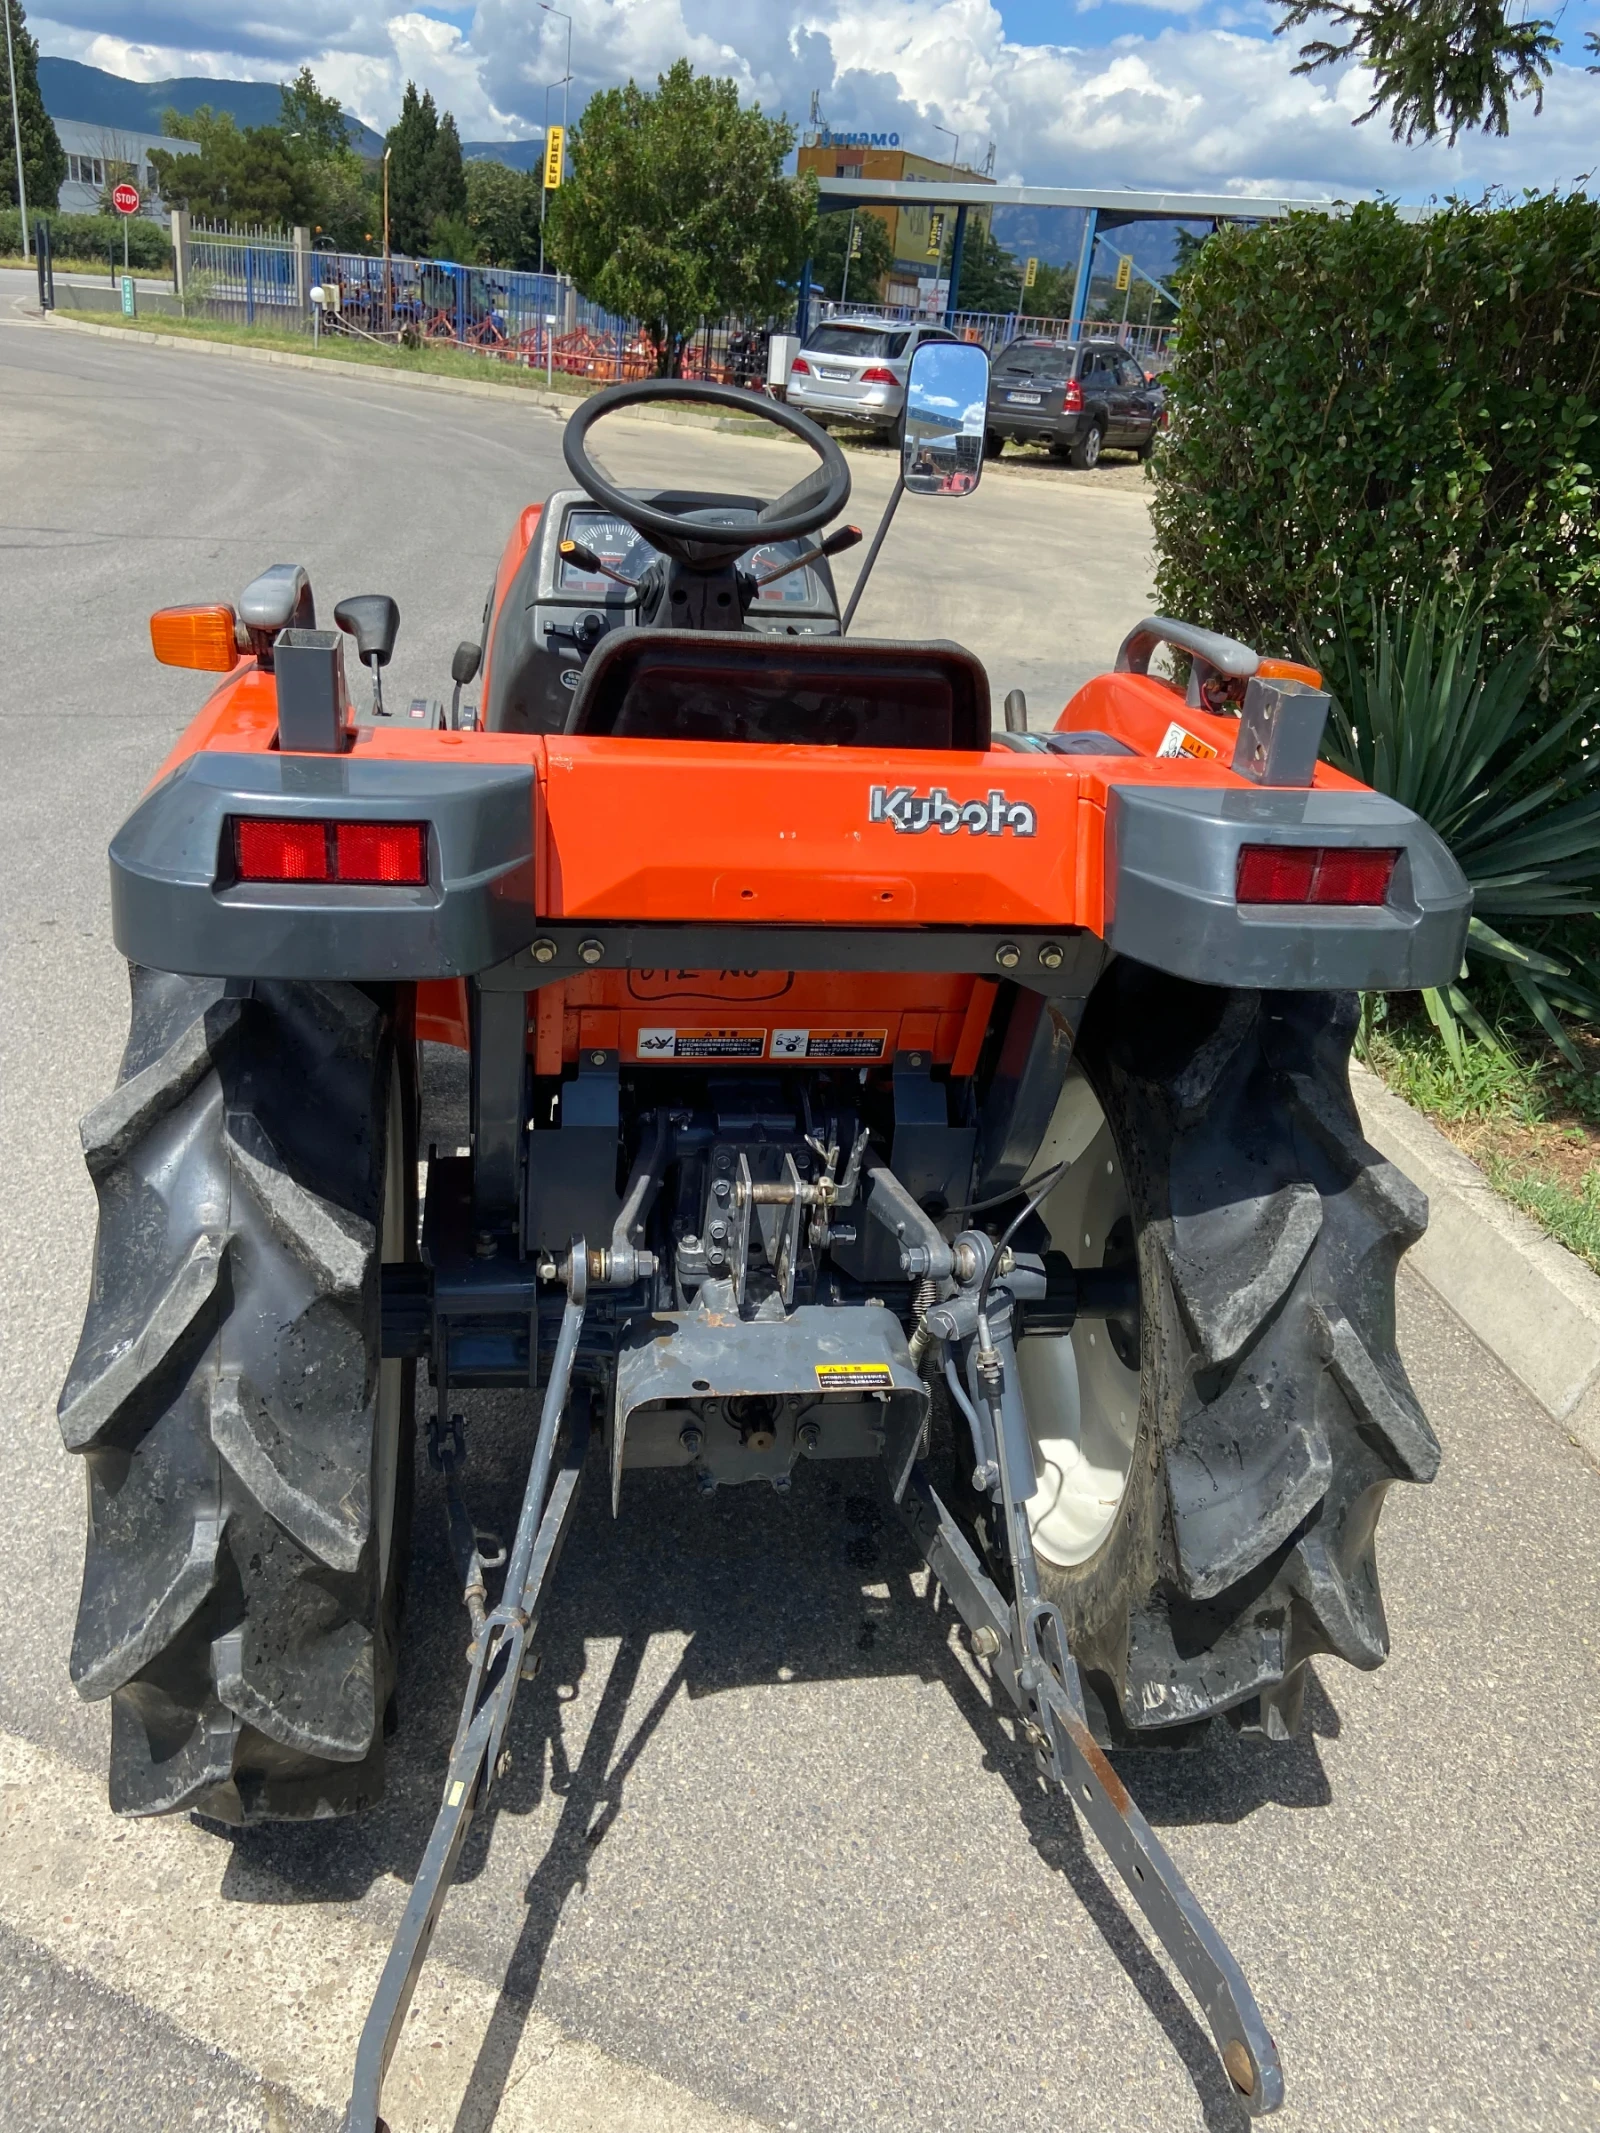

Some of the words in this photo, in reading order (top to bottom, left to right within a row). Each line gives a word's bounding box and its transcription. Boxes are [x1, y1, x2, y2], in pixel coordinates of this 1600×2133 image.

[549, 130, 560, 184] EFBET
[116, 193, 136, 205] STOP
[627, 540, 635, 548] 3
[868, 785, 1037, 837] Kubota
